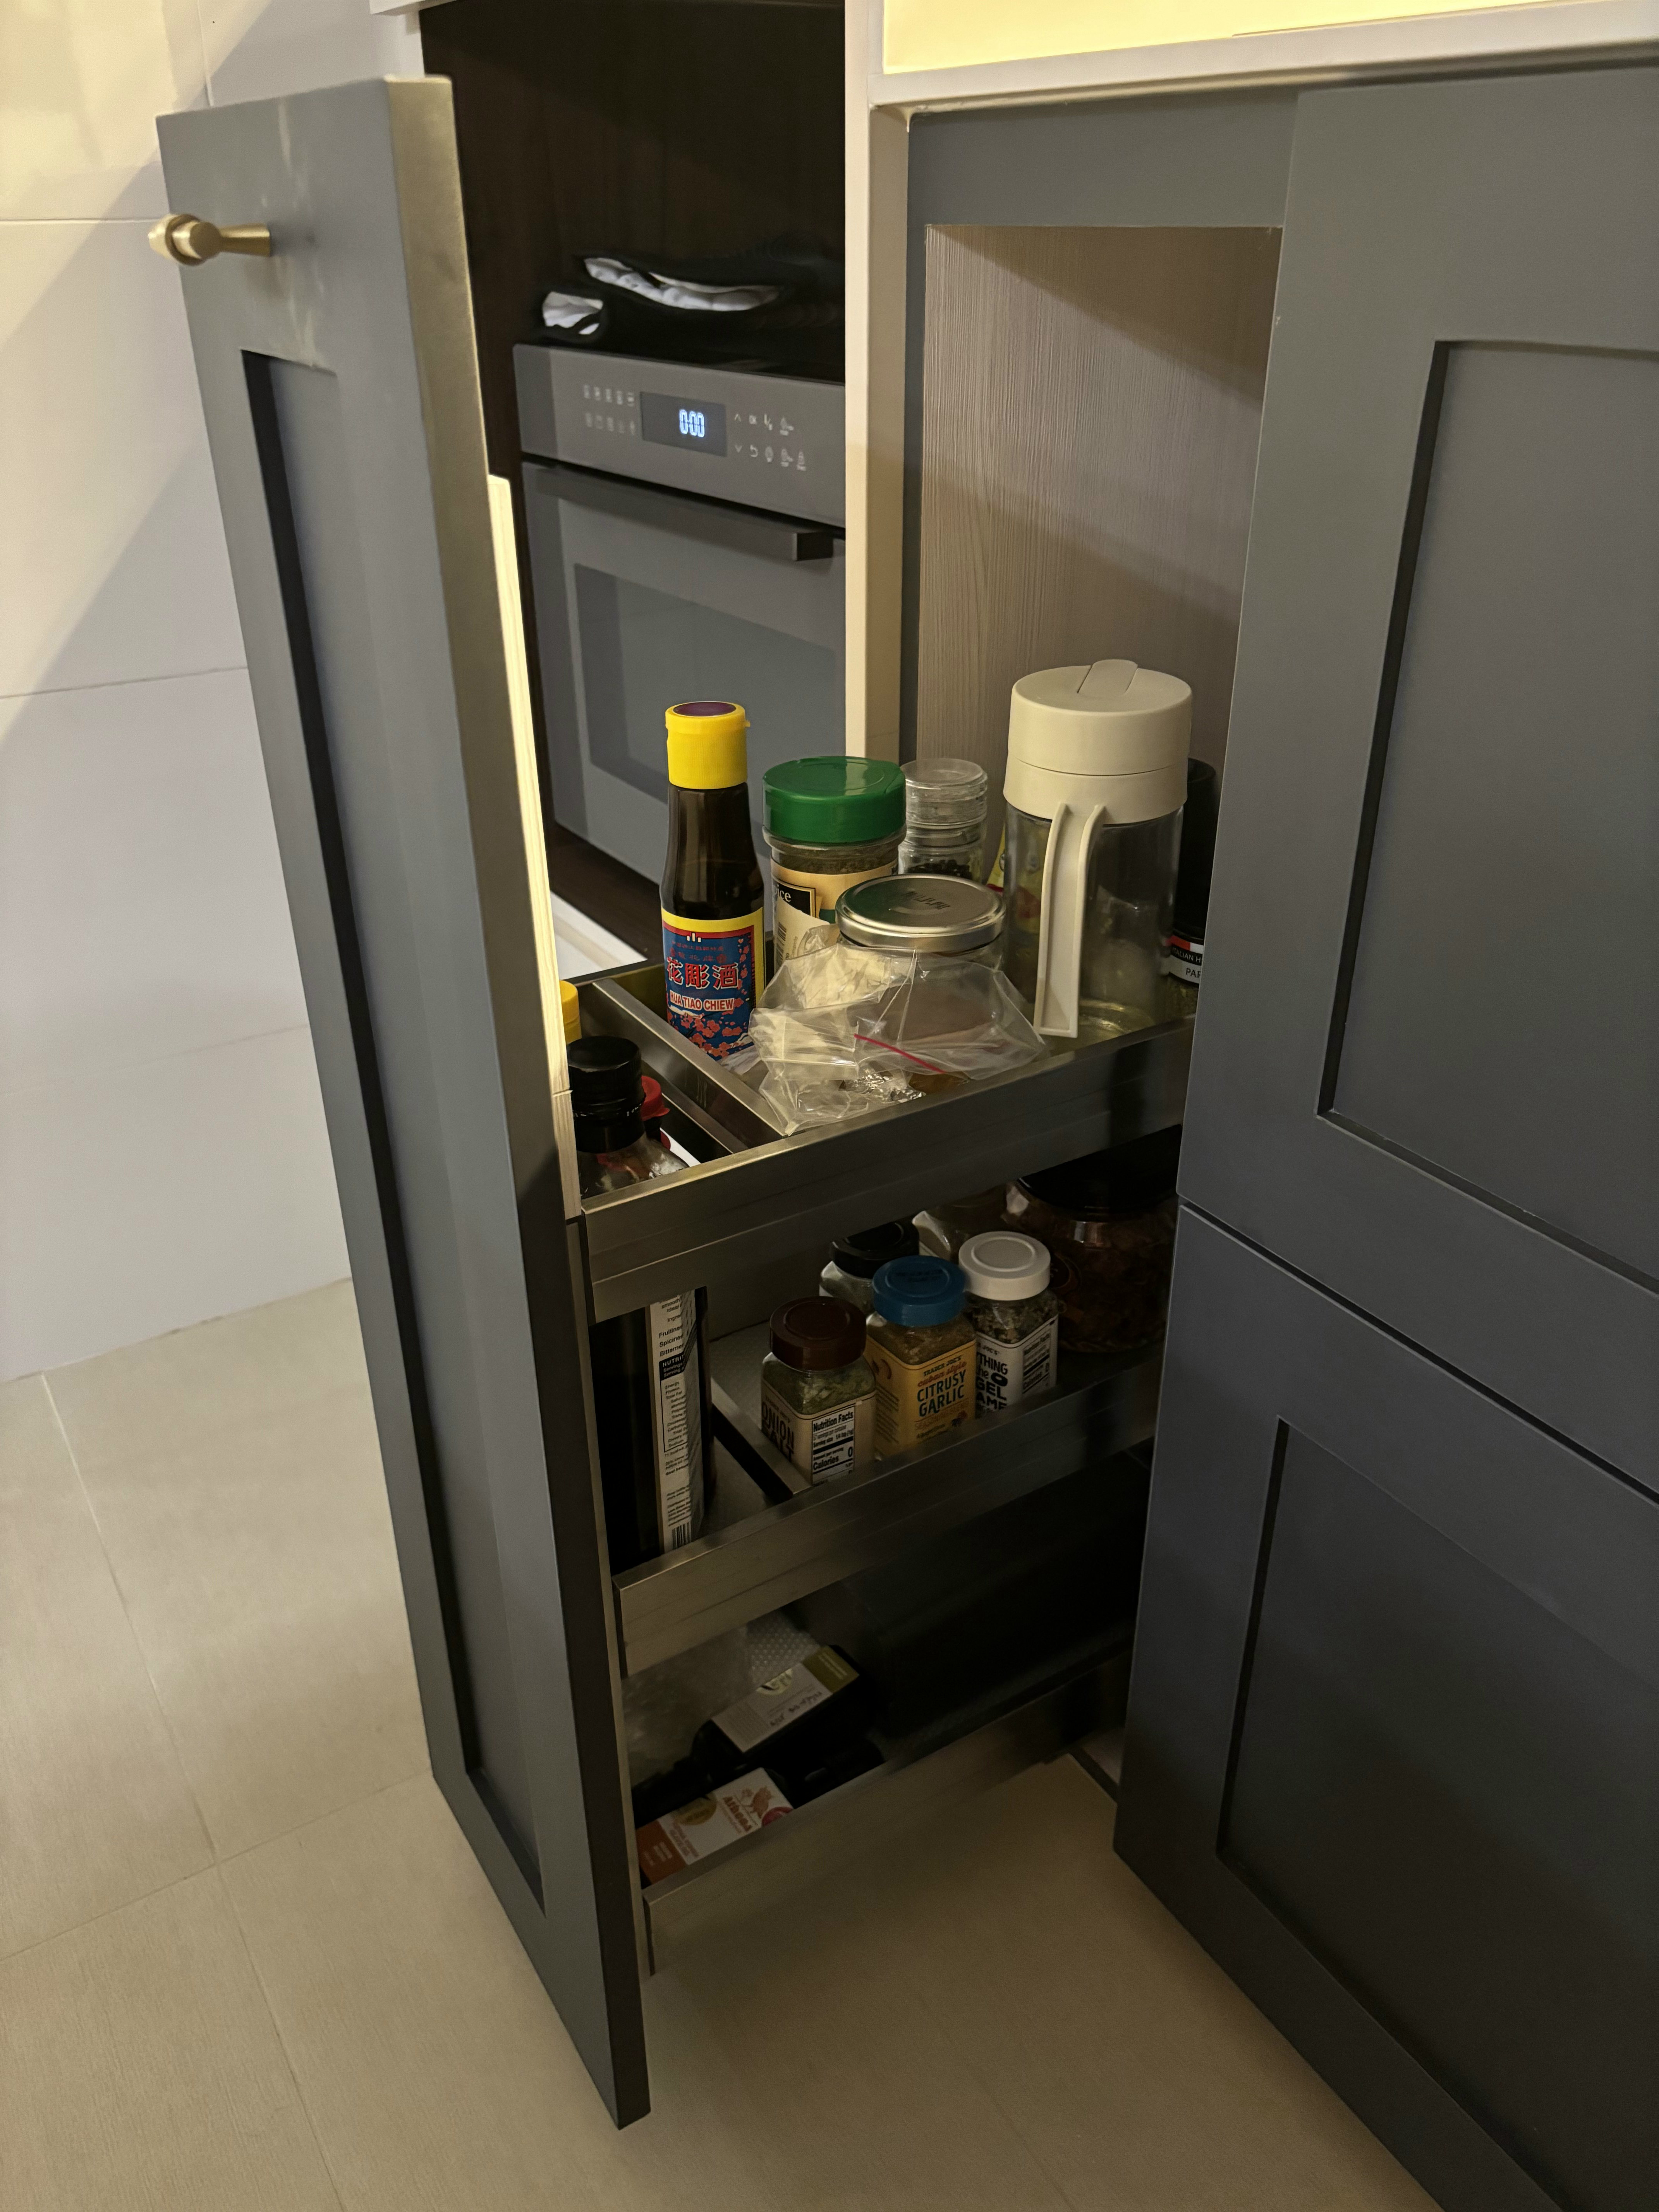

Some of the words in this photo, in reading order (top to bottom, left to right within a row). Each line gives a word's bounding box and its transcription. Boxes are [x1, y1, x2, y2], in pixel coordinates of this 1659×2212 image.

[670, 991, 682, 1006] HUA
[683, 996, 701, 1009] TIAO
[704, 999, 733, 1010] CHIEW
[917, 1369, 966, 1402] CITRUSY
[919, 1384, 964, 1417] GARLIC
[762, 1401, 794, 1449] ONION
[814, 1417, 837, 1432] Nutrition
[838, 1412, 853, 1423] Facts
[813, 1456, 839, 1470] Calories
[848, 1447, 853, 1457] 0
